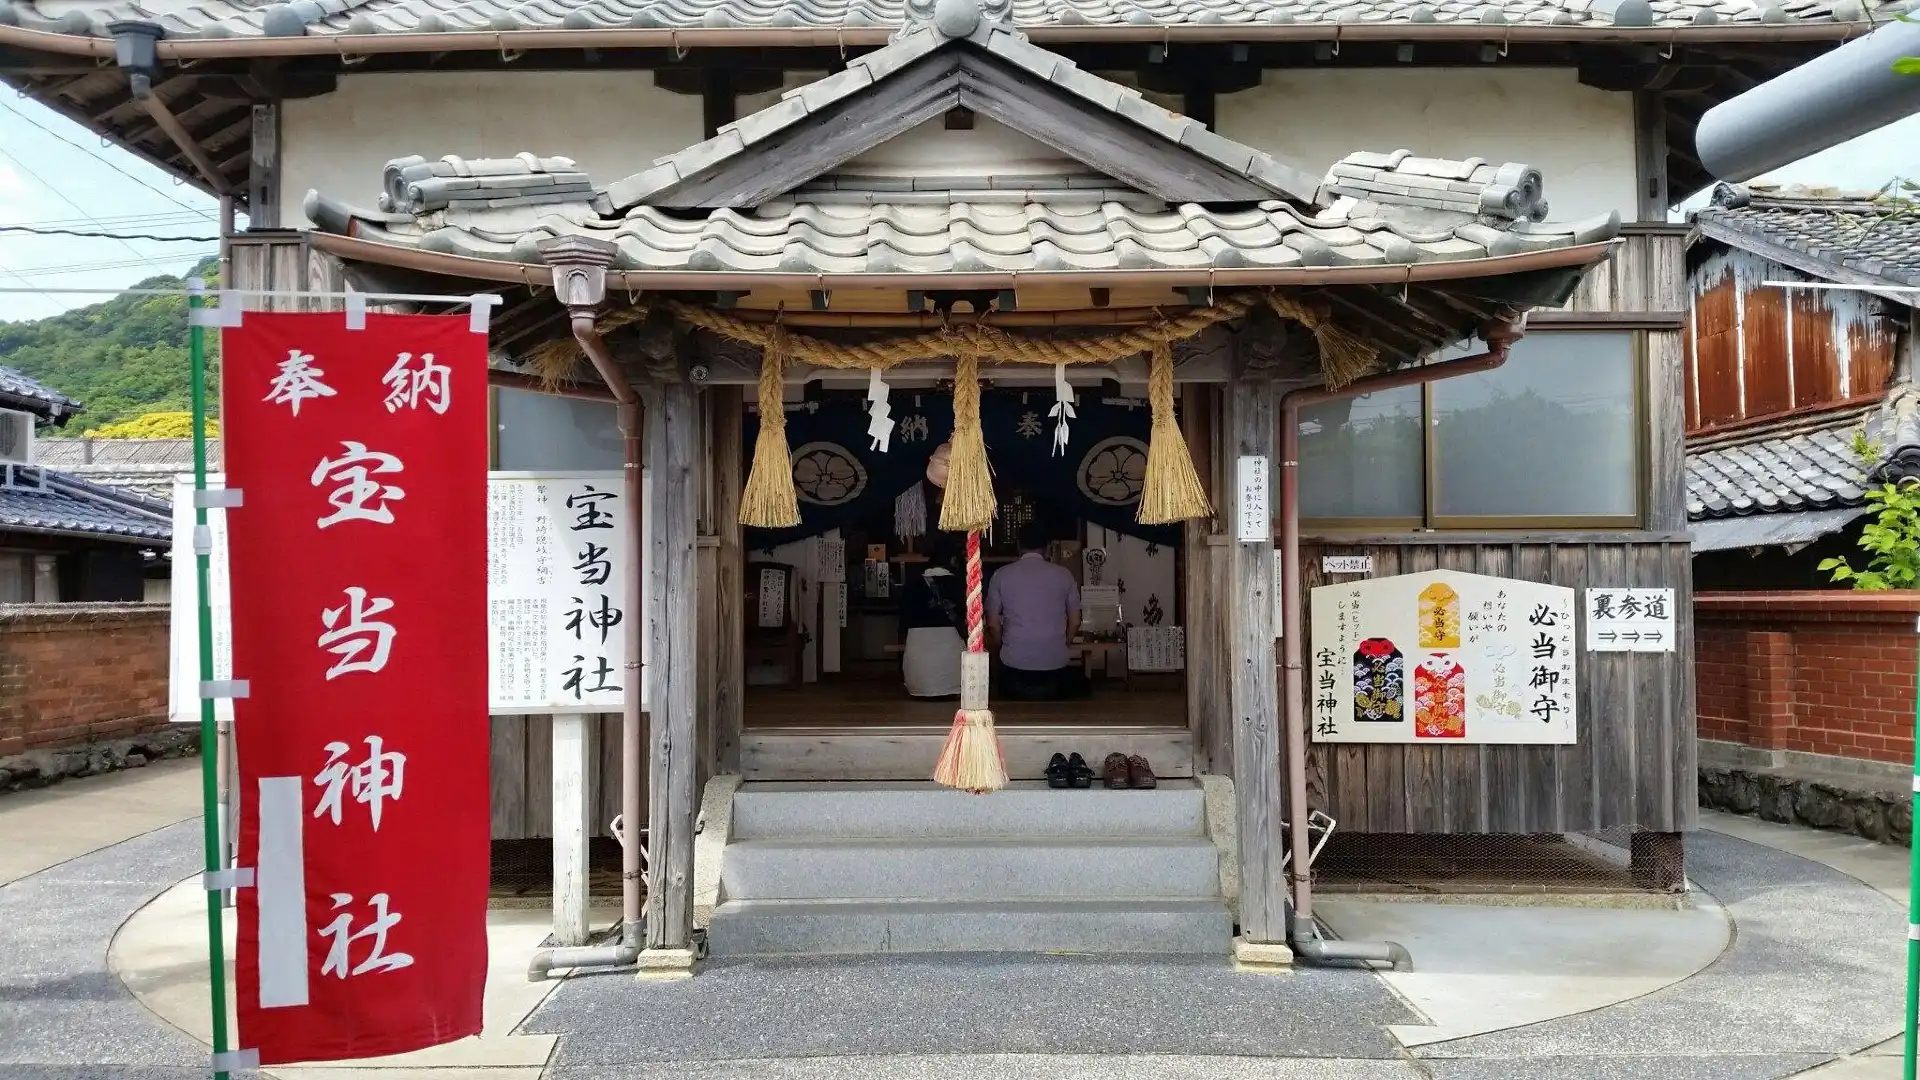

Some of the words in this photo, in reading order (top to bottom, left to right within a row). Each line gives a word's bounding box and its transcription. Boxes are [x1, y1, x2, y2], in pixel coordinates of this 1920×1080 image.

[900, 414, 928, 443] 納
[1017, 410, 1042, 439] 奉
[1325, 560, 1370, 570] ペット禁止
[561, 485, 623, 700] 宝当神社
[1592, 594, 1669, 620] 裏参道
[1433, 606, 1446, 641] 必当守
[1483, 601, 1493, 632] 想いや
[1497, 590, 1507, 632] あなたの
[1468, 612, 1479, 644] 願いが
[1528, 603, 1560, 724] 必当御守
[1316, 647, 1338, 736] 宝当神社
[310, 441, 414, 980] 宝当神社
